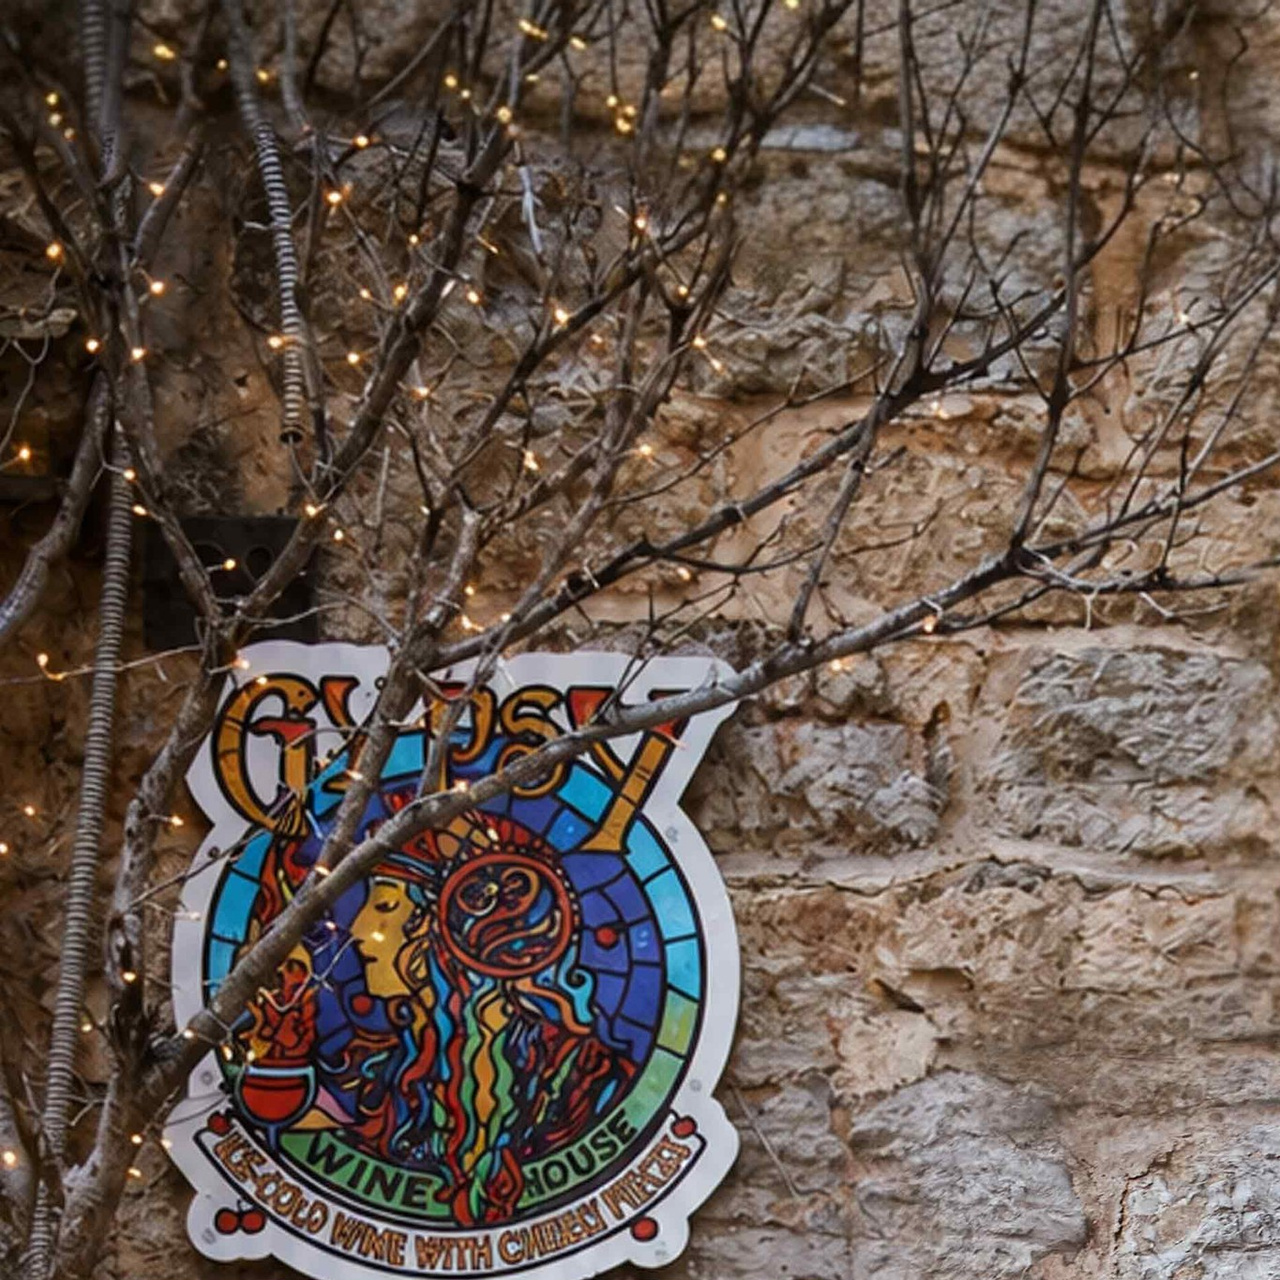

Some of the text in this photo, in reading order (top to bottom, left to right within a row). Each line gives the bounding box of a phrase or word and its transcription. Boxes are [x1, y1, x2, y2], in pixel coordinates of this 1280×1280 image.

[306, 1130, 433, 1210] WINE
[526, 1107, 638, 1198] HOUSE
[330, 1210, 407, 1266] WINE
[414, 1234, 494, 1271] WITH
